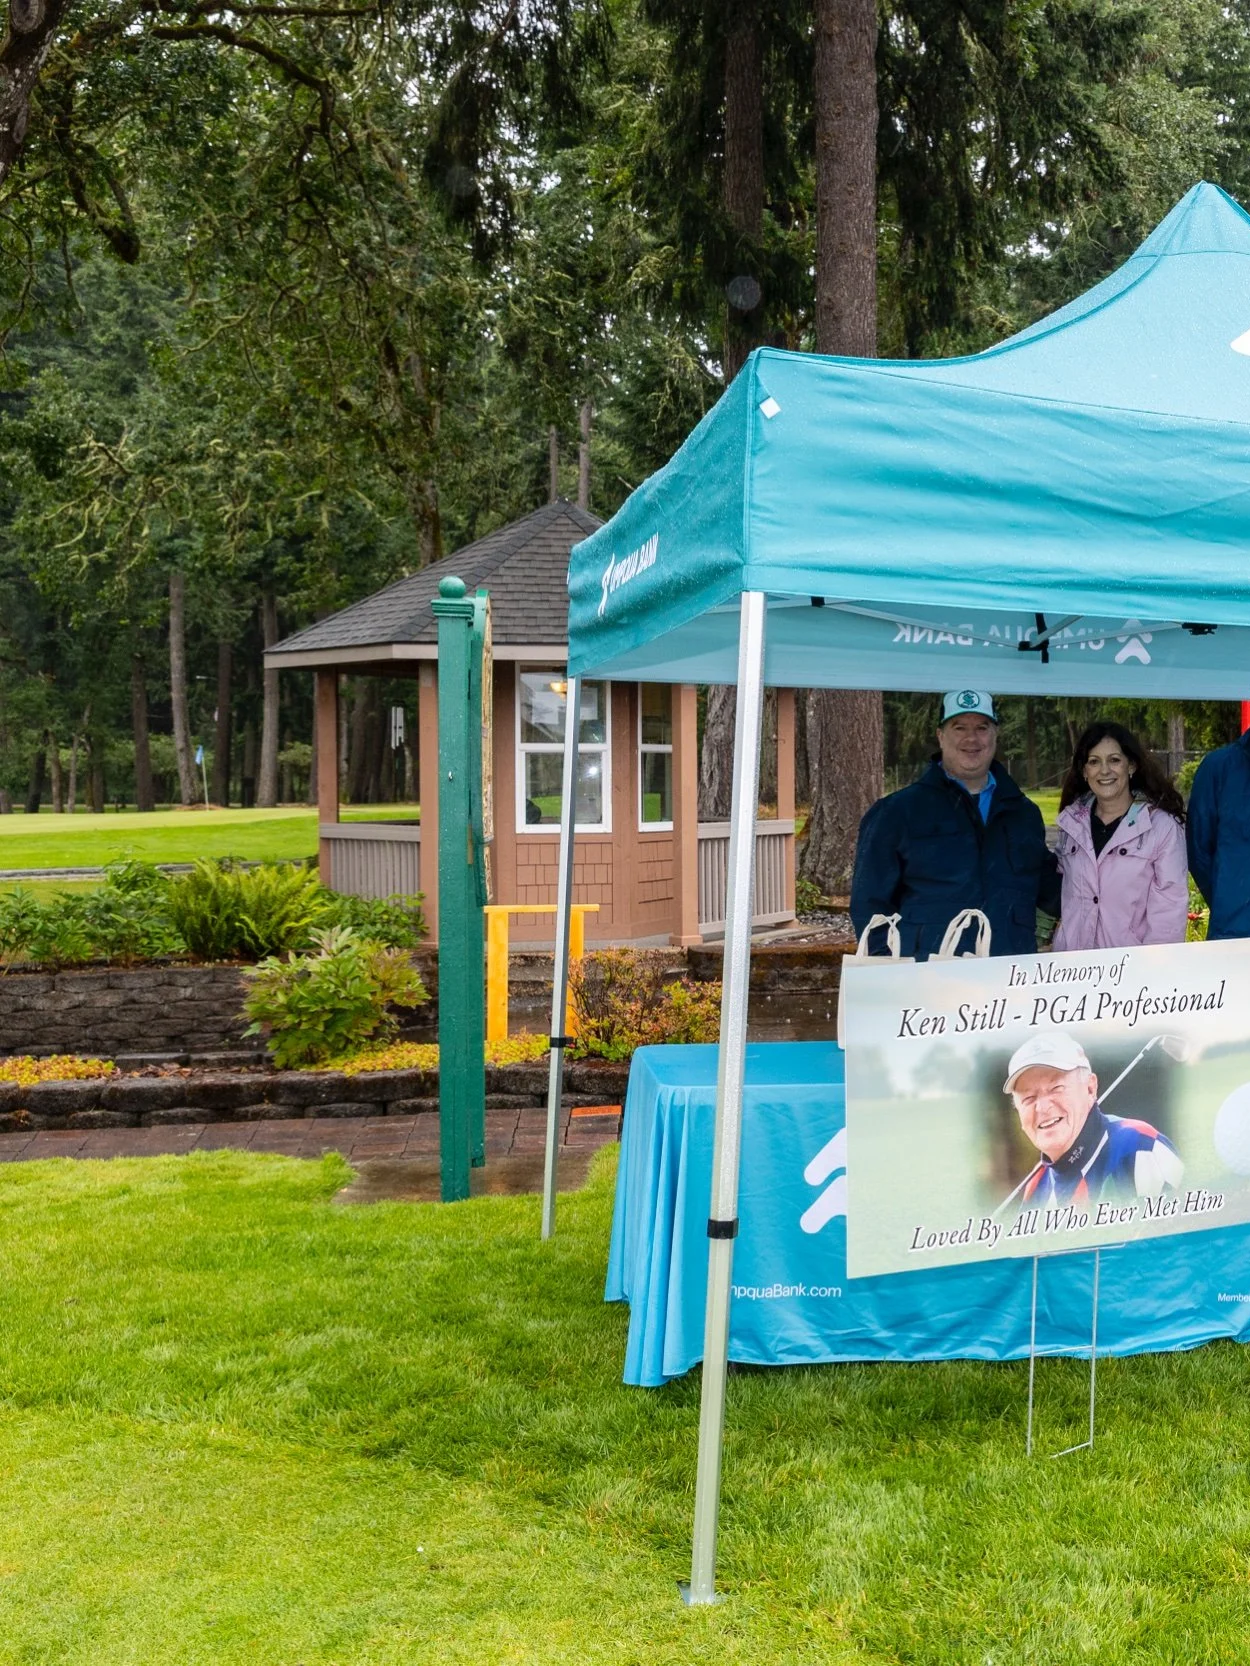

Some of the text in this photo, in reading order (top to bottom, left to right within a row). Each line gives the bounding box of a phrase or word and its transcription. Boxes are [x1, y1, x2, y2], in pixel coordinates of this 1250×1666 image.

[1008, 954, 1129, 988] In Memory of
[897, 1007, 947, 1038] Ken
[954, 998, 1007, 1033] Still
[1029, 994, 1087, 1027] PGA
[1094, 980, 1226, 1027] Professional
[910, 1190, 1225, 1250] Loved By All Who Ever Met Him
